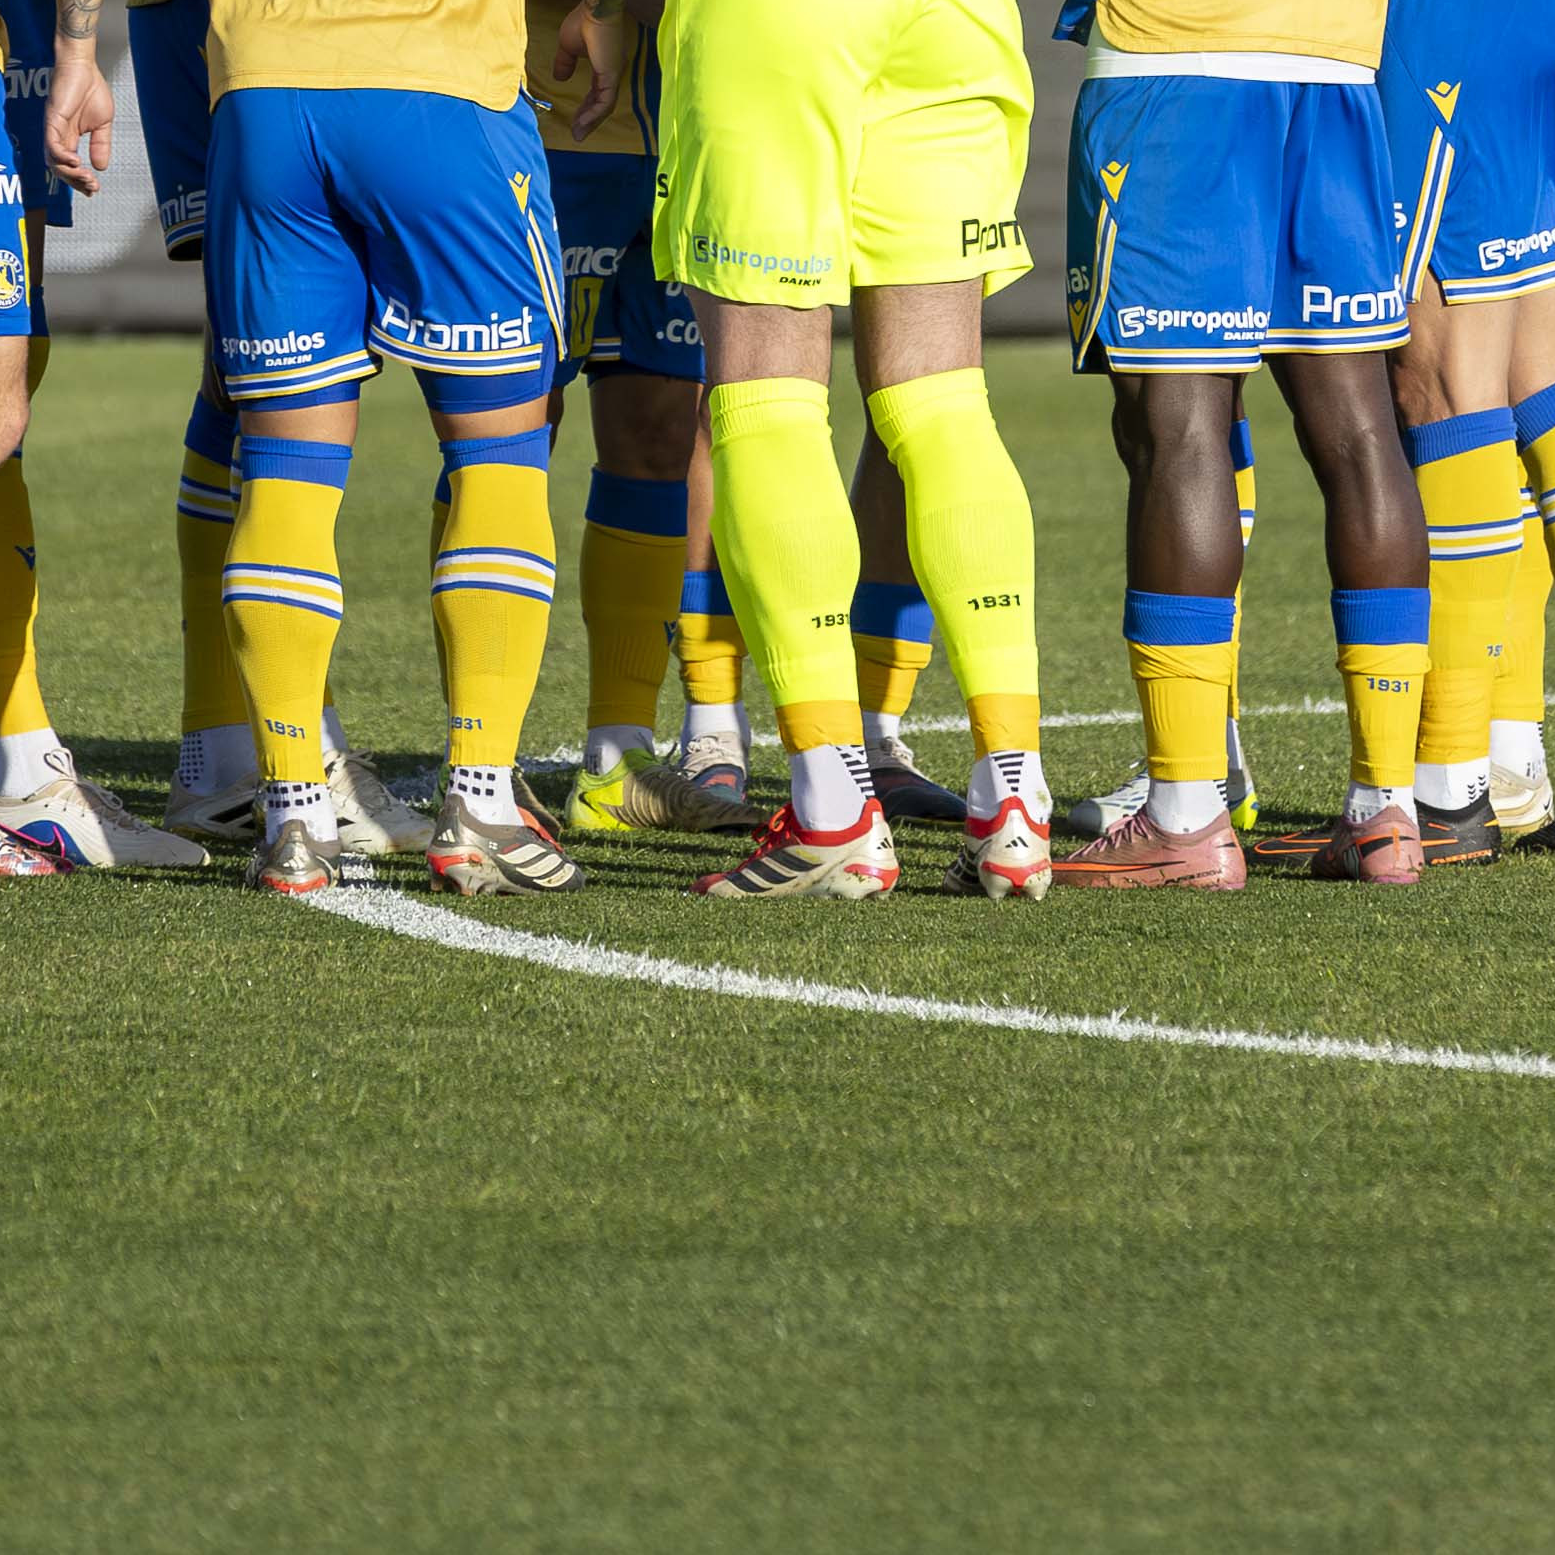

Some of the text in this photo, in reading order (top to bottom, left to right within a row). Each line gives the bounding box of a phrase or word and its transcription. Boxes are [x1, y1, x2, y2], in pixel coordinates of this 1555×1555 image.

[381, 297, 533, 351] Promist
[265, 354, 313, 367] DAIKIN
[967, 594, 1022, 611] 1931
[1366, 677, 1410, 694] 1931
[265, 719, 306, 740] 1931
